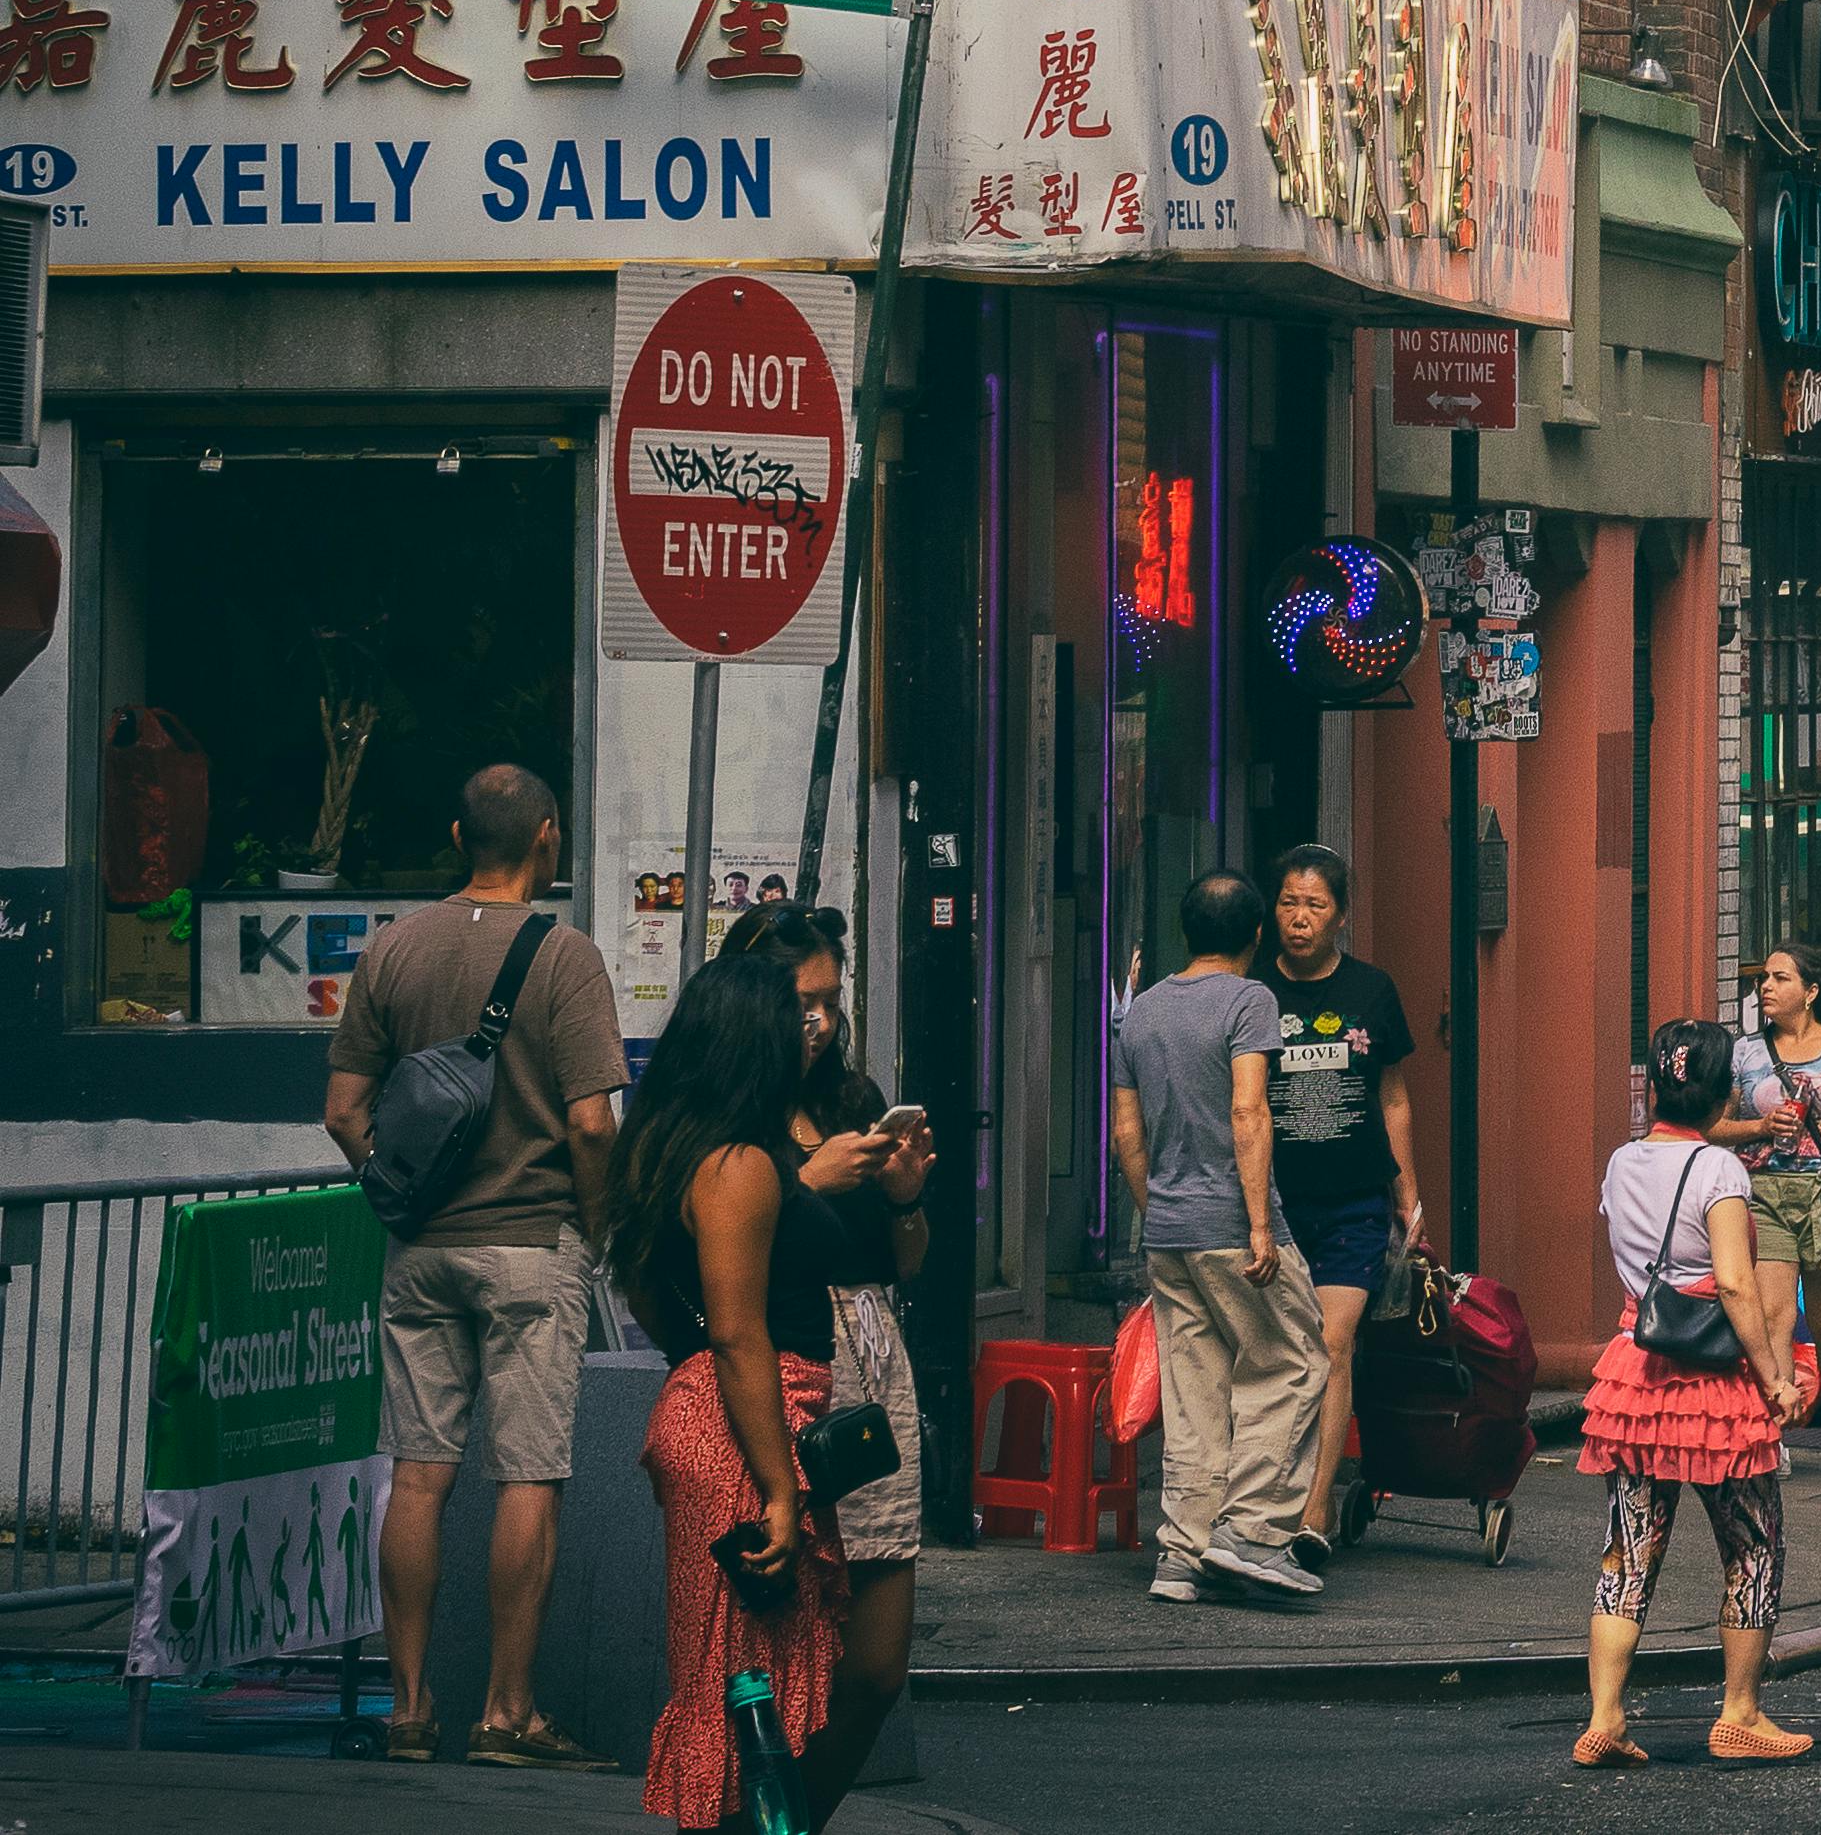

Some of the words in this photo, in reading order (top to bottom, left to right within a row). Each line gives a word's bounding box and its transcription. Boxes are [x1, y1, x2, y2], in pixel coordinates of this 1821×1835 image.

[5, 150, 56, 190] 19
[1182, 126, 1217, 178] 19
[155, 140, 431, 228] KELLY
[482, 136, 773, 224] SALON
[53, 204, 89, 229] ST.
[1167, 197, 1209, 231] PELL
[1214, 197, 1238, 232] ST.
[1400, 330, 1422, 353] NO
[1430, 330, 1509, 355] STANDING
[658, 349, 712, 407] DO
[730, 352, 807, 412] NOT
[1412, 362, 1497, 384] ANYTIME
[662, 521, 789, 580] ENTER
[1513, 714, 1538, 730] ROOTS
[1288, 1046, 1340, 1062] LOVE
[249, 1231, 329, 1294] Welcome!
[304, 1301, 375, 1385] Street
